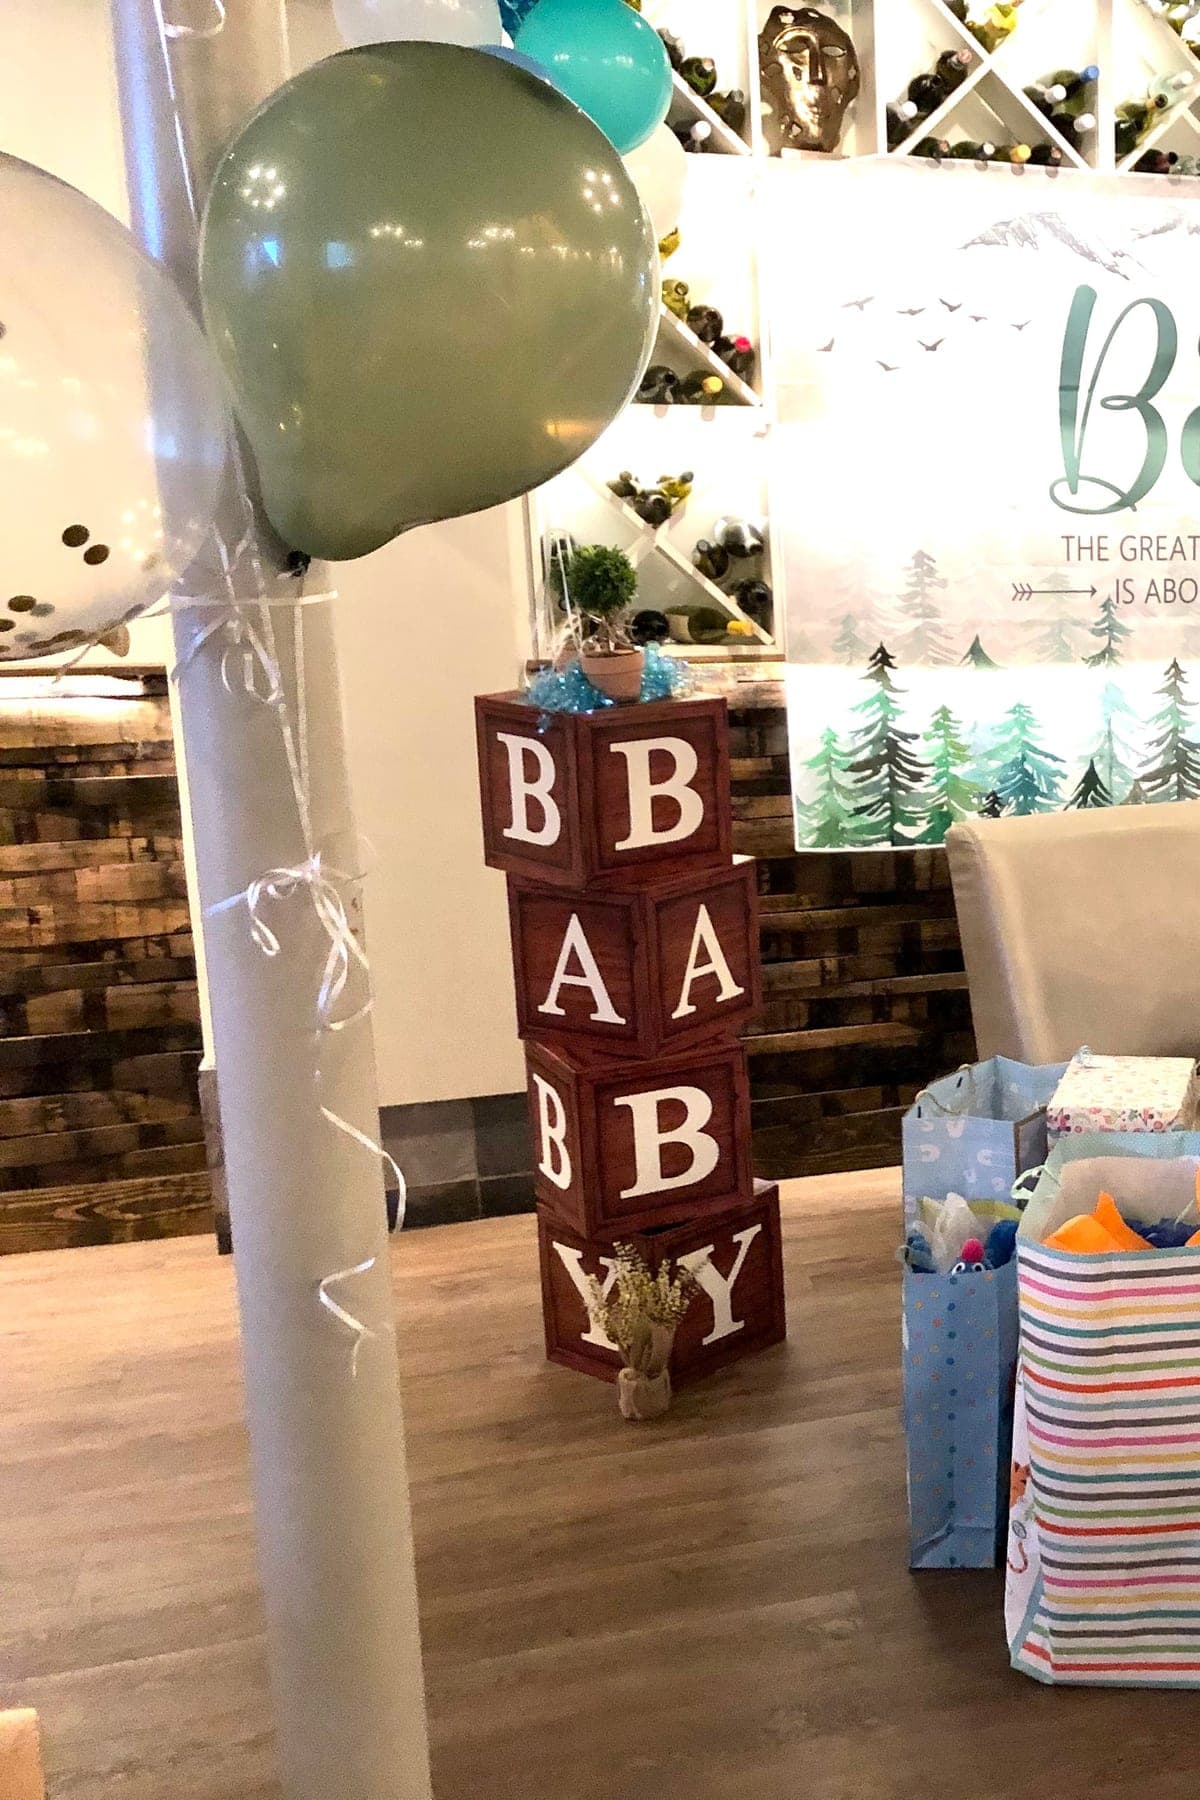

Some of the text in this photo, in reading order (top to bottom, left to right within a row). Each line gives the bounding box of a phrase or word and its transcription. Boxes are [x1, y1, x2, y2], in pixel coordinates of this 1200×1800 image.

[1061, 535, 1110, 562] THE
[1115, 577, 1135, 605] IS
[496, 731, 562, 847] B
[610, 735, 704, 851] B
[537, 912, 627, 1025] A
[671, 903, 745, 1019] A
[532, 1072, 572, 1191] B
[614, 1085, 720, 1200] B
[676, 1223, 762, 1346] Y
